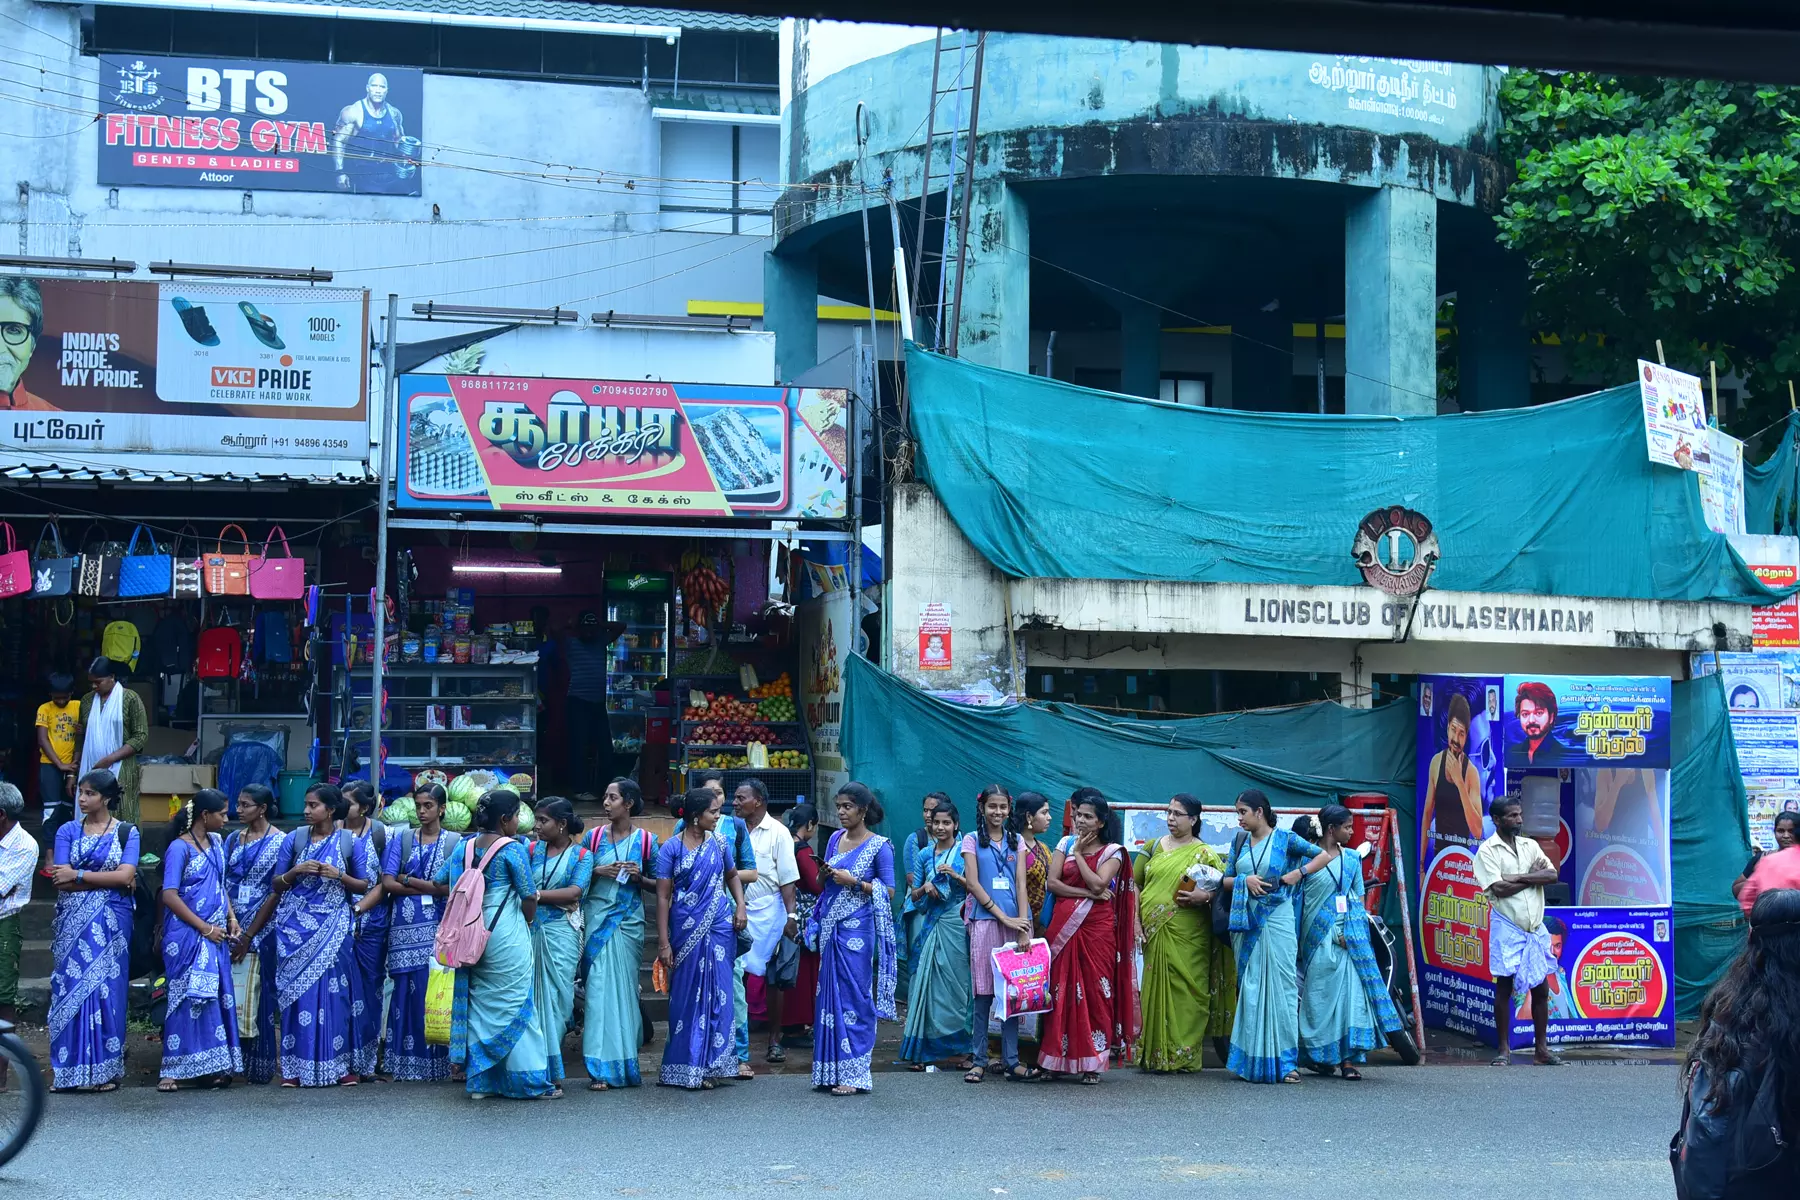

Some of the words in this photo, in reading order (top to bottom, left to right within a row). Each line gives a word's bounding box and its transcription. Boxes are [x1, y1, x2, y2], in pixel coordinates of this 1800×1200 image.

[120, 76, 158, 95] BTS
[187, 66, 288, 115] BTS
[105, 113, 241, 152] FITNESS
[249, 118, 328, 153] GYM
[137, 154, 196, 166] GENTS
[209, 157, 219, 167] &
[230, 157, 295, 169] LADIES
[199, 171, 234, 183] Attoor
[308, 317, 341, 332] 1000+
[62, 331, 120, 351] INDIA'S
[309, 333, 335, 342] MODELS
[62, 350, 113, 369] PRIDE.
[61, 369, 90, 387] MY
[93, 369, 144, 389] PRIDE.
[213, 368, 252, 385] VKC
[258, 368, 312, 390] PRIDE
[461, 380, 529, 391] 9688117219
[602, 385, 668, 397] 7094502790
[210, 388, 256, 400] CELEBRATE
[259, 390, 281, 401] HARD
[285, 391, 313, 402] WORK.
[13, 418, 106, 442] புட்வேர்
[220, 432, 268, 450] ஆற்றூர்
[294, 437, 320, 448] 94896
[322, 438, 348, 449] 43549
[515, 490, 589, 503] ஸ்வீட்ஸ்
[601, 494, 614, 503] &
[627, 494, 691, 506] கேக்ஸ்
[1366, 508, 1429, 538] LIONS
[1387, 530, 1410, 571] L
[1245, 598, 1371, 626] LIONSCLUB
[1423, 603, 1594, 633] KULASEKHARAM
[1574, 705, 1653, 735] தண்ணீர்
[1585, 729, 1646, 760] பந்தல்
[1425, 884, 1489, 931] தண்ணீர்
[1434, 920, 1484, 968] பந்தல்
[1578, 957, 1654, 987] தண்ணீர்
[1590, 979, 1646, 1010] பந்தல்
